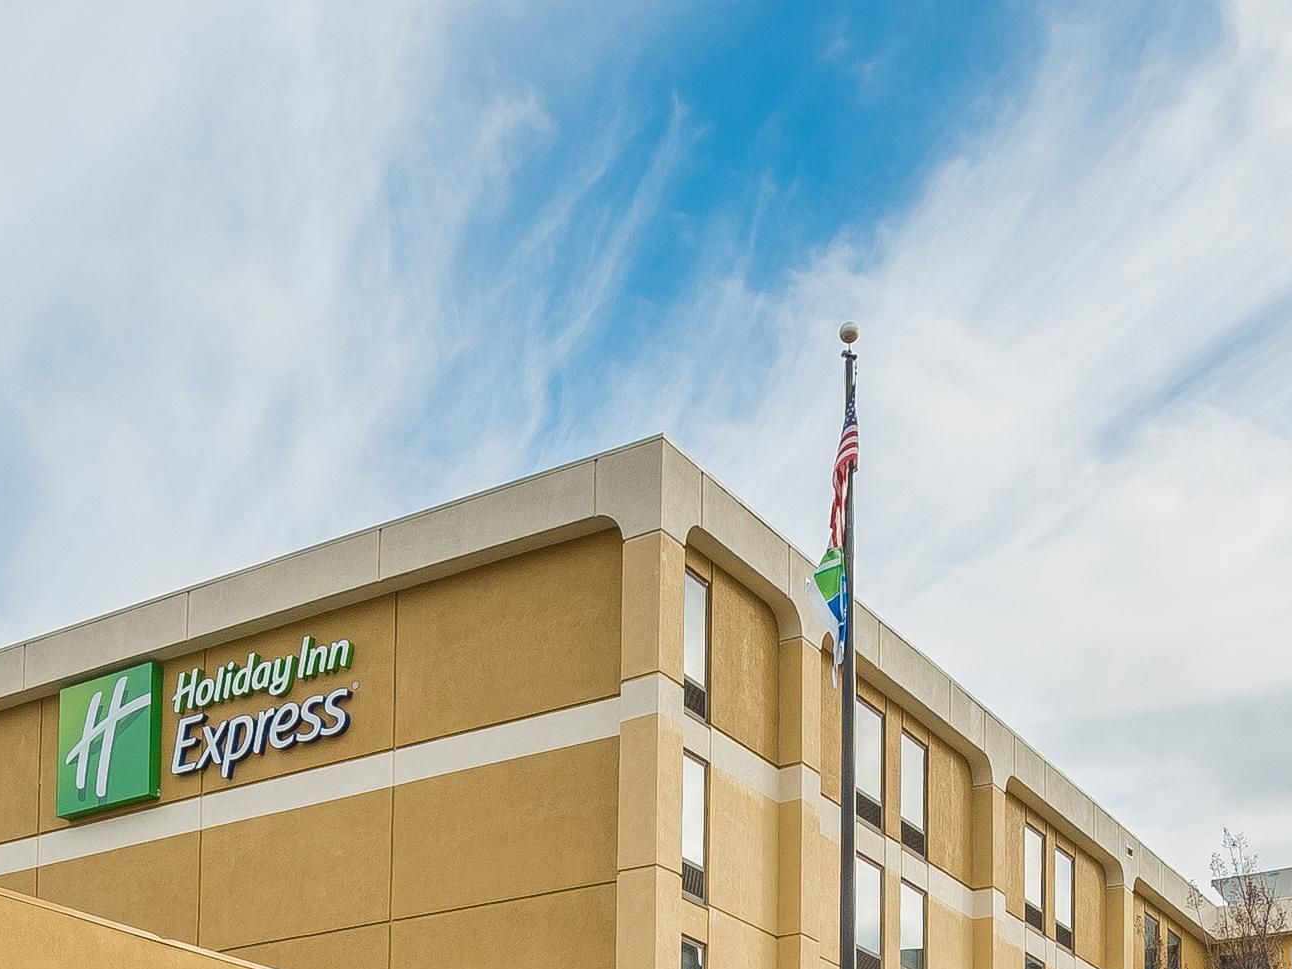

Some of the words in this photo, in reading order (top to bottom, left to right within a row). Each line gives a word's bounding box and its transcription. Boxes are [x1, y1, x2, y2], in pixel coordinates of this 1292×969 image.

[172, 653, 294, 714] Holiday
[296, 635, 354, 680] Inn
[171, 687, 353, 779] Express
